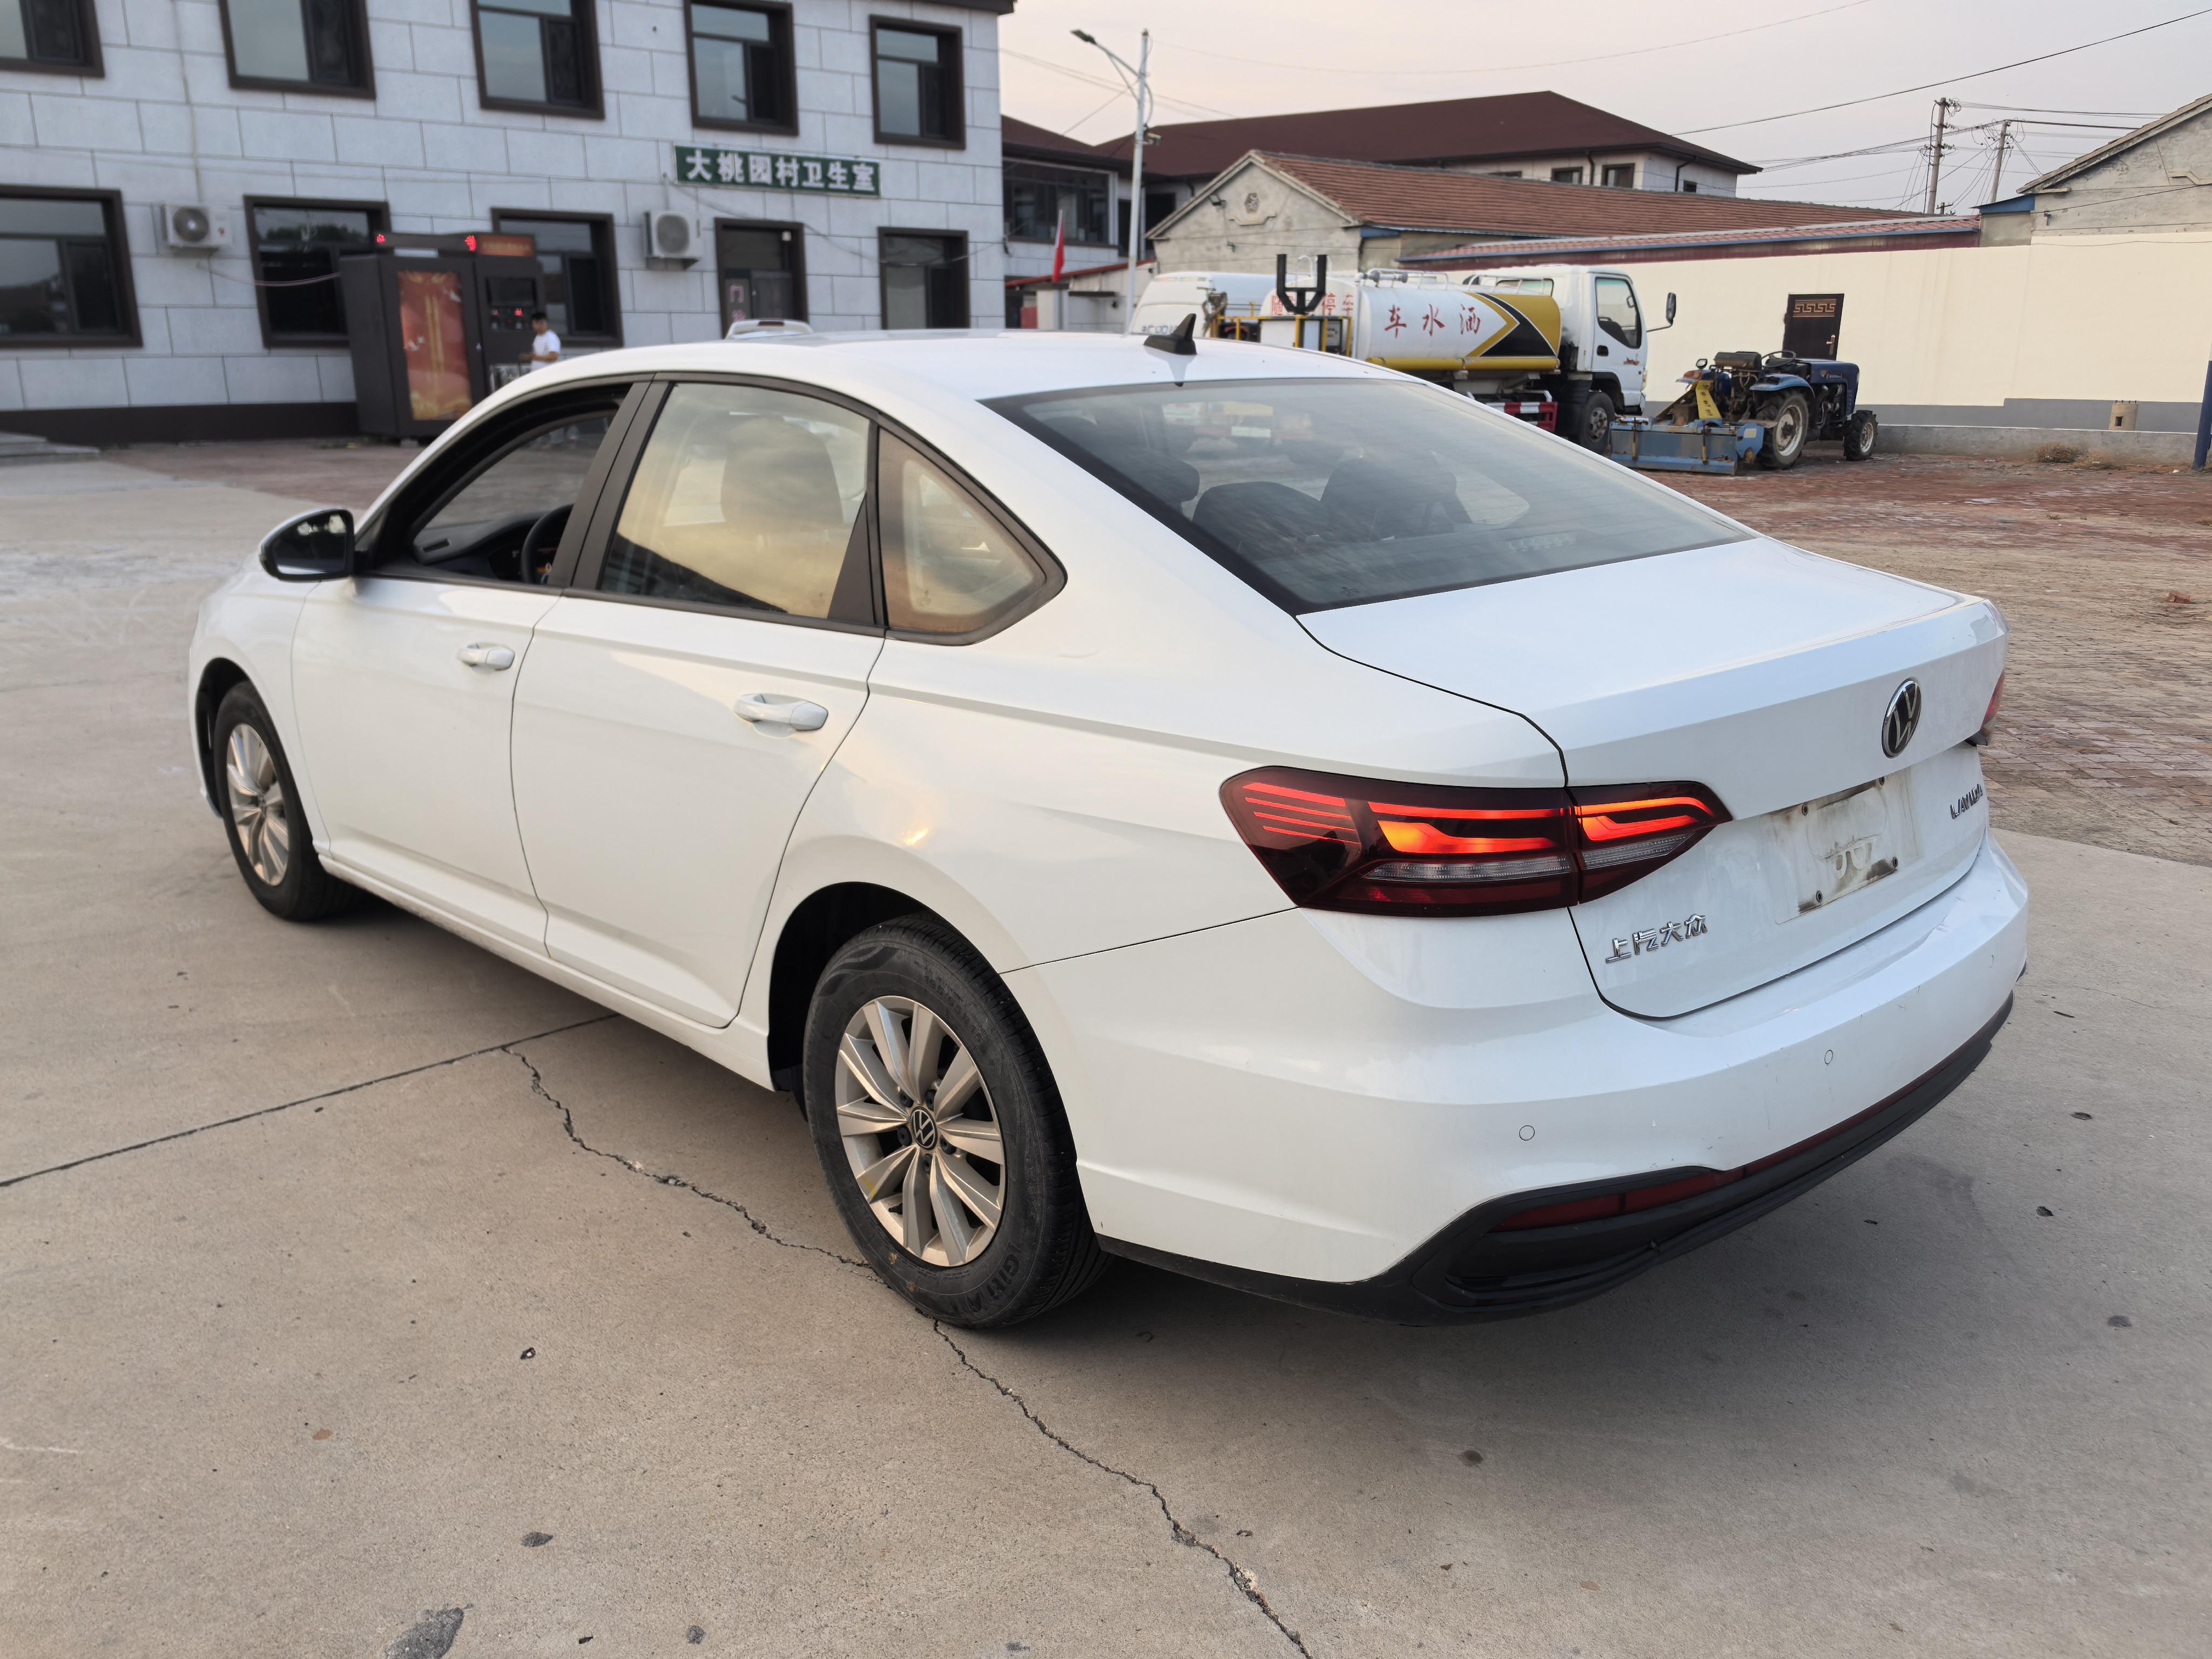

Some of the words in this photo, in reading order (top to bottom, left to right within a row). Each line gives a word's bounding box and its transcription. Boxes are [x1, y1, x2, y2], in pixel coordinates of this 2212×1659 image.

[685, 149, 875, 191] 大桃园村卫生室
[1606, 913, 1708, 963] 上汽大众
